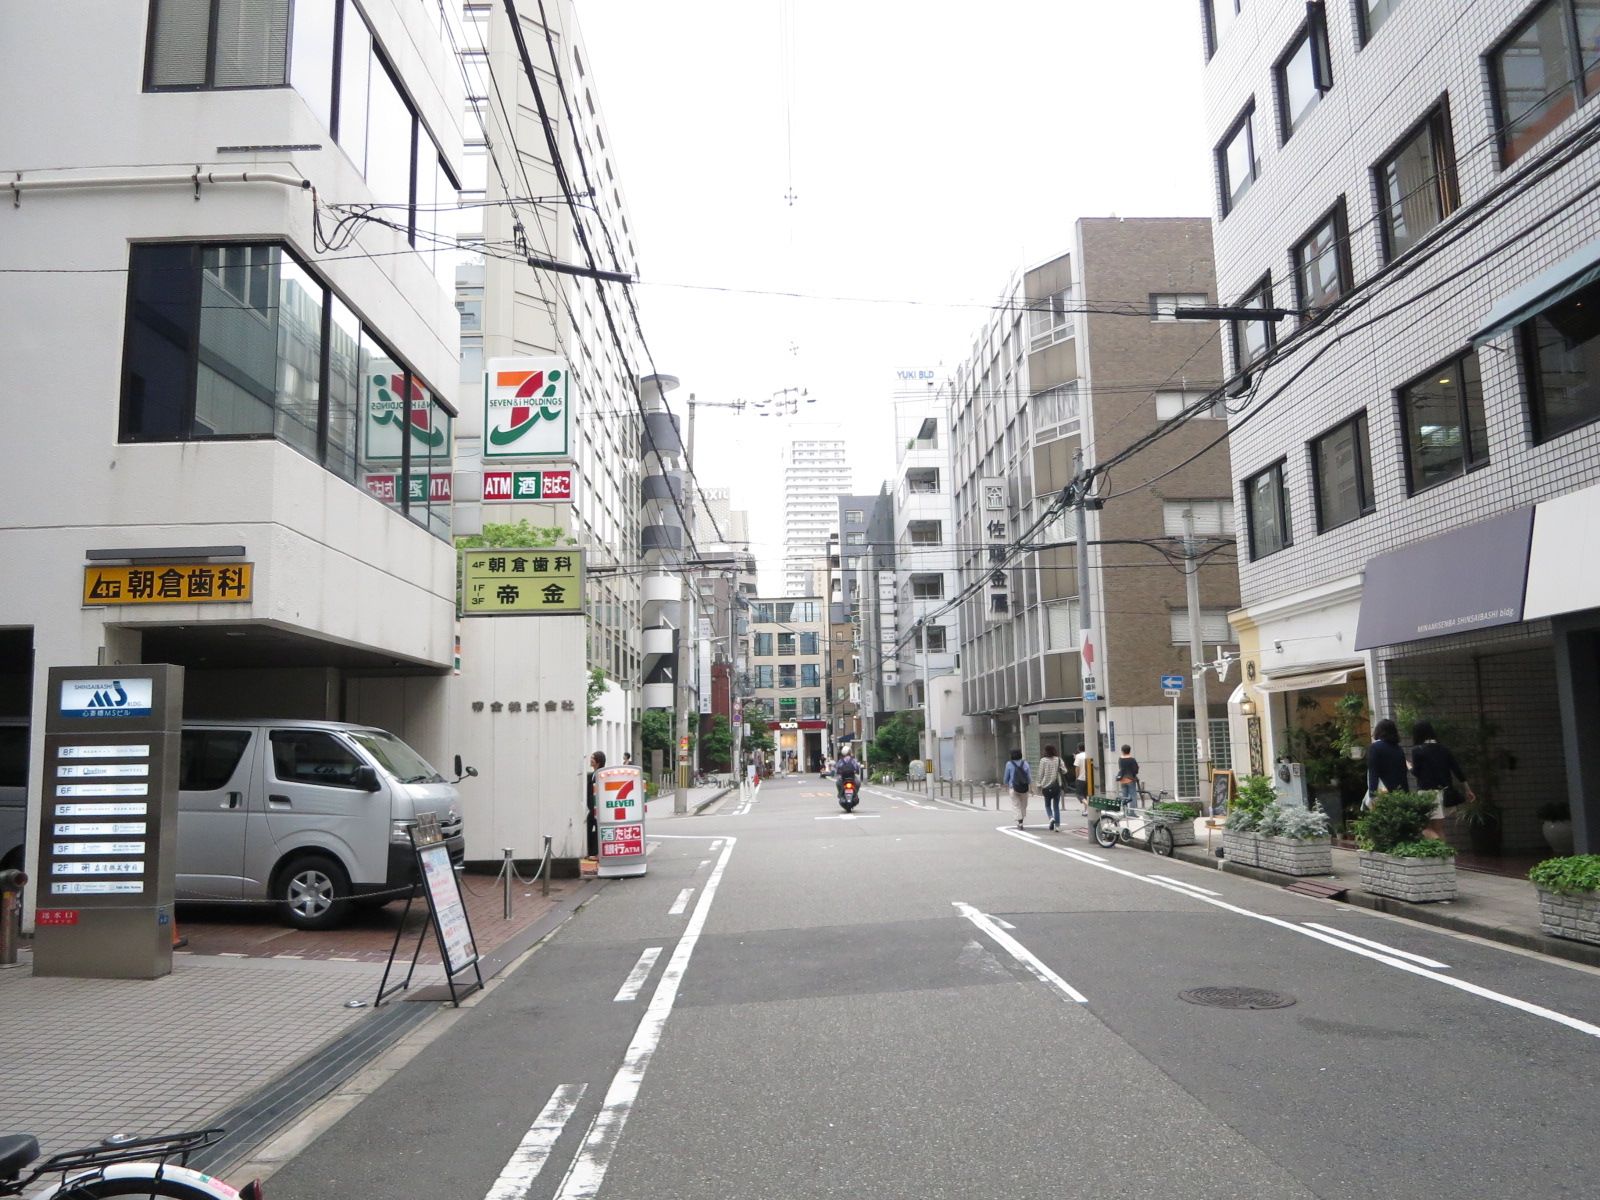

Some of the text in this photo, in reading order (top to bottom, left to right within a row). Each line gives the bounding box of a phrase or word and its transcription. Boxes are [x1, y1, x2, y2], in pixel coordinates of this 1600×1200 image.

[896, 370, 934, 379] YUKI BLD
[523, 398, 563, 406] HOLDINGS
[485, 477, 511, 495] ATM
[518, 476, 536, 495] 酒
[543, 476, 569, 493] たばこ
[488, 556, 572, 573] 朝倉歯科
[97, 567, 246, 599] 4F 朝倉歯科
[473, 584, 485, 592] 1F
[471, 597, 485, 605] 3F
[1457, 609, 1498, 625] SHINSAIBASHI
[63, 748, 74, 756] 8F
[61, 767, 73, 775] 7F
[60, 787, 72, 795] 6F
[59, 806, 71, 814] 5F
[58, 825, 70, 833] 4F
[615, 826, 641, 840] たばこ
[57, 845, 69, 853] 3F
[57, 864, 69, 872] 2F
[56, 884, 68, 892] 1F
